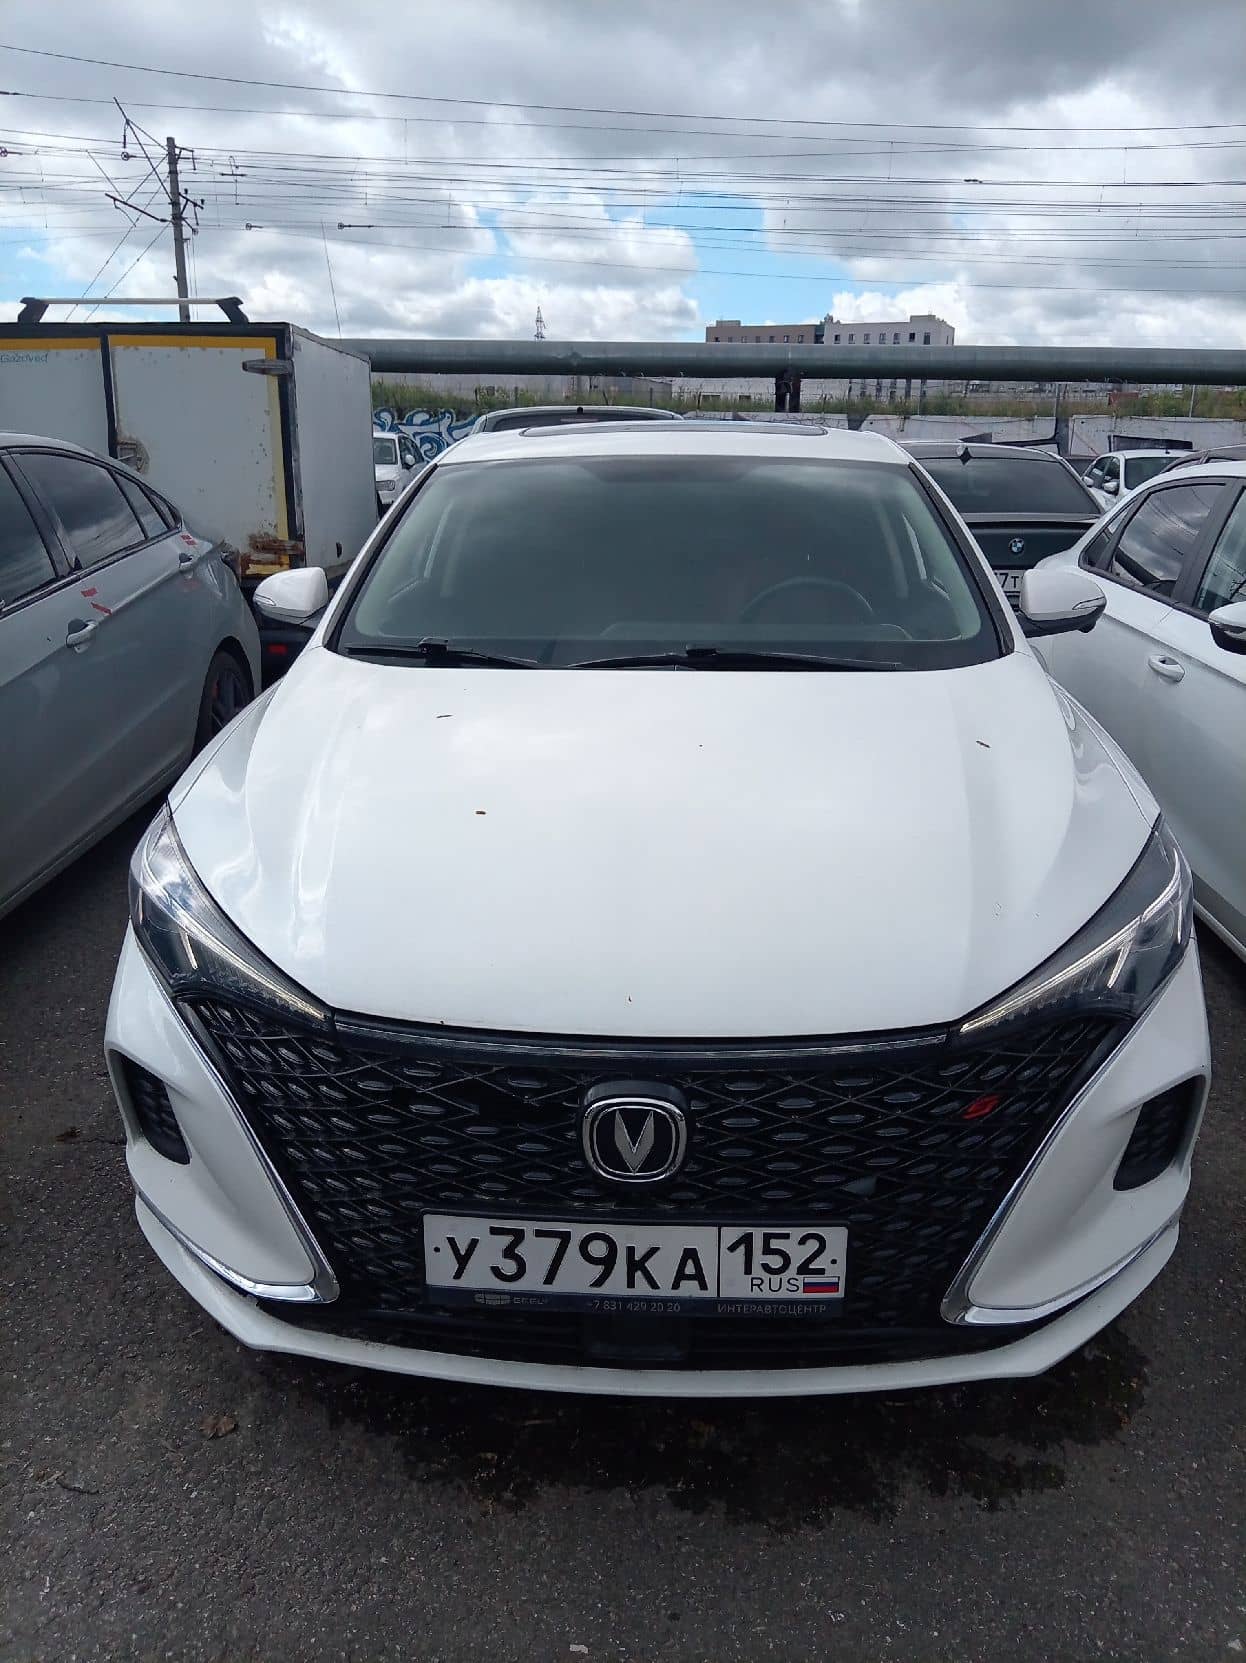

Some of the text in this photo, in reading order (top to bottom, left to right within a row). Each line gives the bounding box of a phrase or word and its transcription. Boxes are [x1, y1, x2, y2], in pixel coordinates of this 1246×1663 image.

[446, 1226, 827, 1291] У379КА 152
[750, 1277, 799, 1293] RUS
[603, 1301, 622, 1312] 831
[650, 1302, 664, 1313] 20
[667, 1302, 681, 1313] 20
[717, 1303, 827, 1315] ИНТЕРАВТОЦЕНТР
